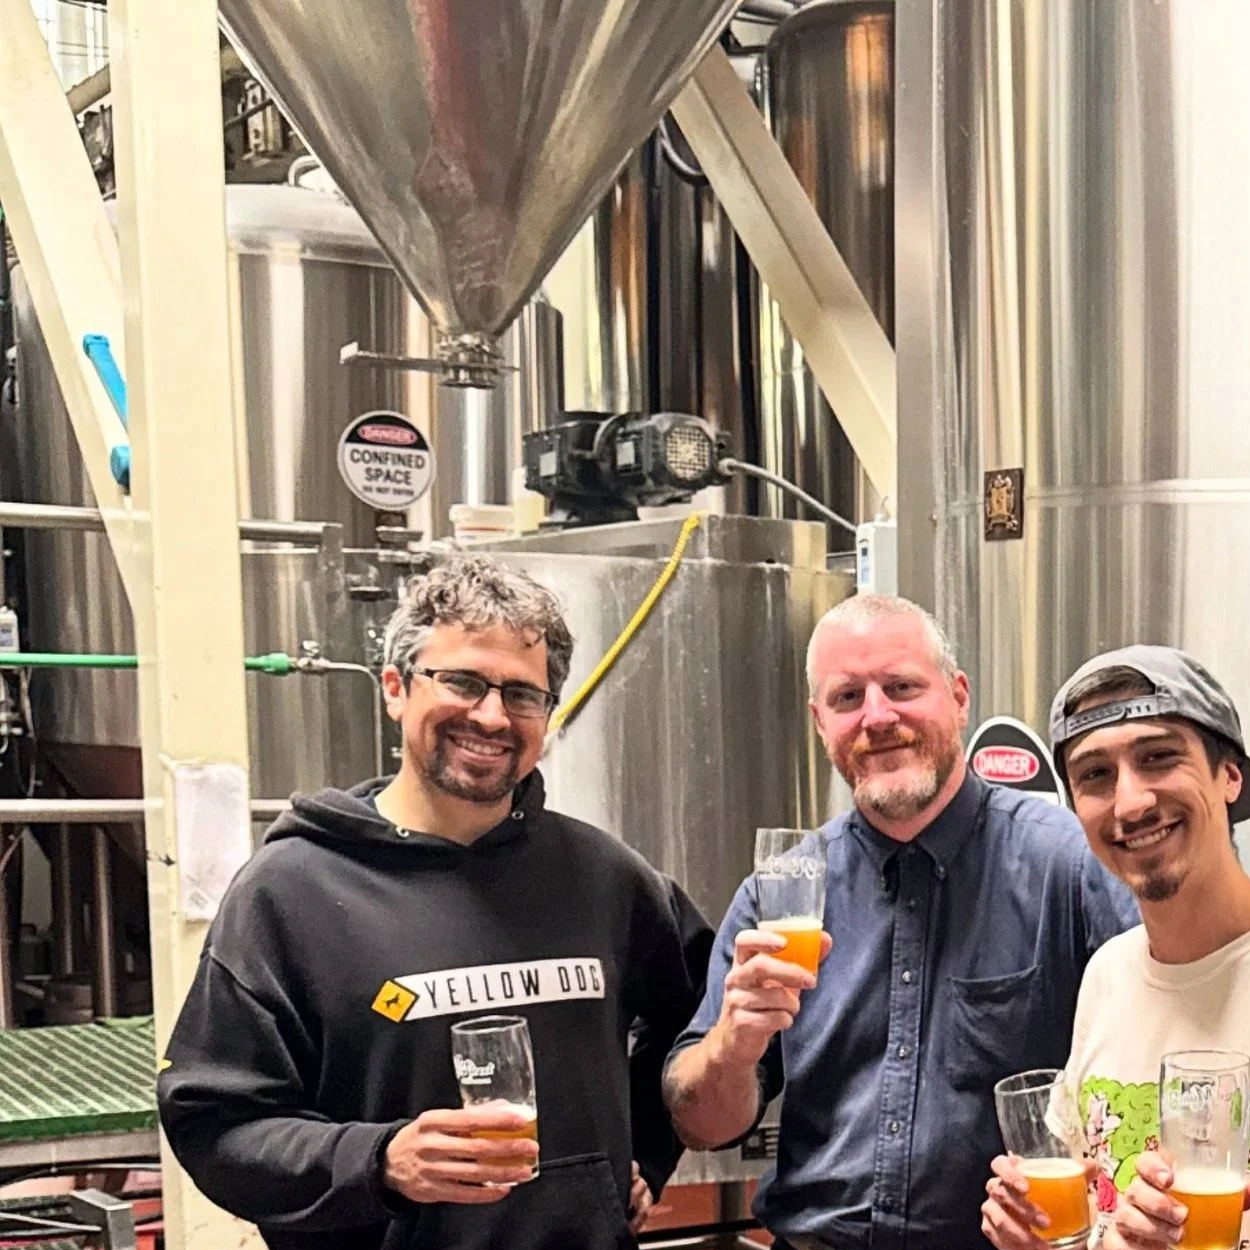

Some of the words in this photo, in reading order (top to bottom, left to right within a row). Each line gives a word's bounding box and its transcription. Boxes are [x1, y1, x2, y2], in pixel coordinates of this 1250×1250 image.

[350, 448, 425, 470] CONFINED
[364, 466, 411, 486] SPACE
[979, 752, 1030, 776] DANGER
[424, 967, 541, 1009] YELLOW
[557, 964, 601, 993] DOG
